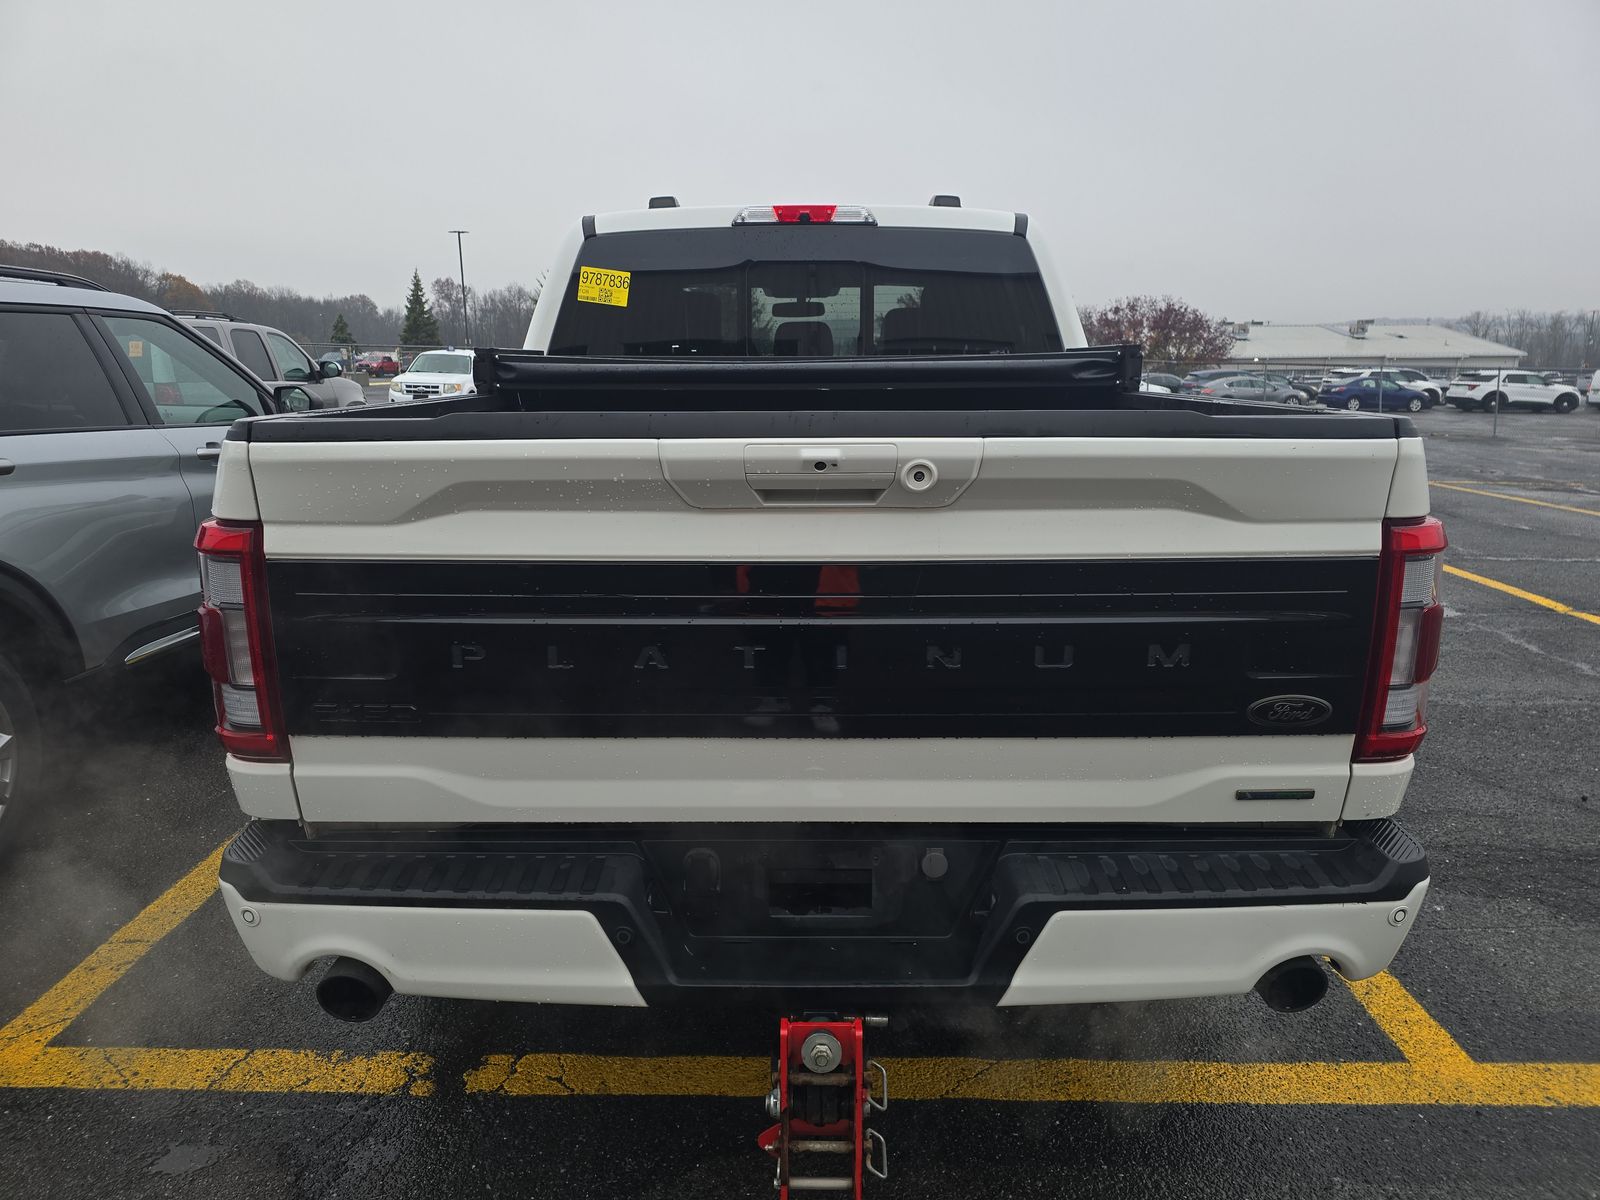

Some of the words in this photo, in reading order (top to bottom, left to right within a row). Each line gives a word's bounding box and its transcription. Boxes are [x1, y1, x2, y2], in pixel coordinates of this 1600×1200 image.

[581, 271, 630, 289] 9787836
[452, 643, 1191, 668] PLATINUM
[1269, 702, 1315, 720] Ford
